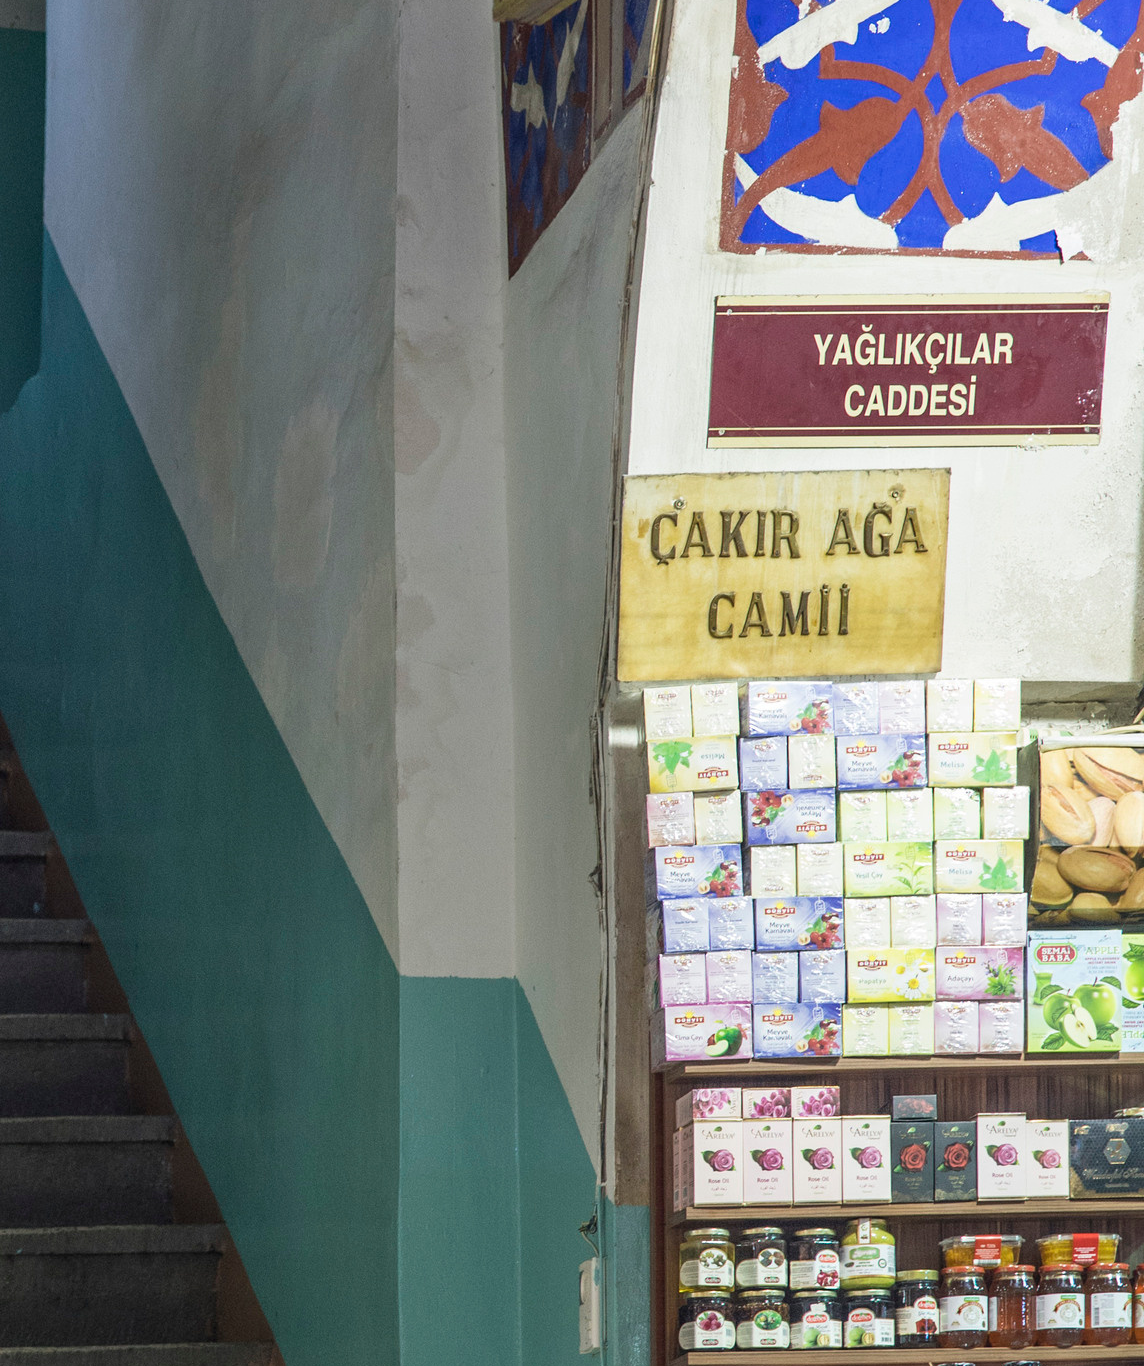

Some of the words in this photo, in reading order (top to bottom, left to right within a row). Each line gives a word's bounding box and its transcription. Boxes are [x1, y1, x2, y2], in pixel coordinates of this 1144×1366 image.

[813, 324, 1014, 374] YAĞLIKÇILAR
[844, 375, 977, 417] CADDESİ
[650, 507, 802, 565] ÇAKIR
[825, 501, 929, 557] AĞA
[708, 583, 851, 639] CAMİİ
[1041, 954, 1071, 963] BABA
[1085, 946, 1121, 955] APPLE
